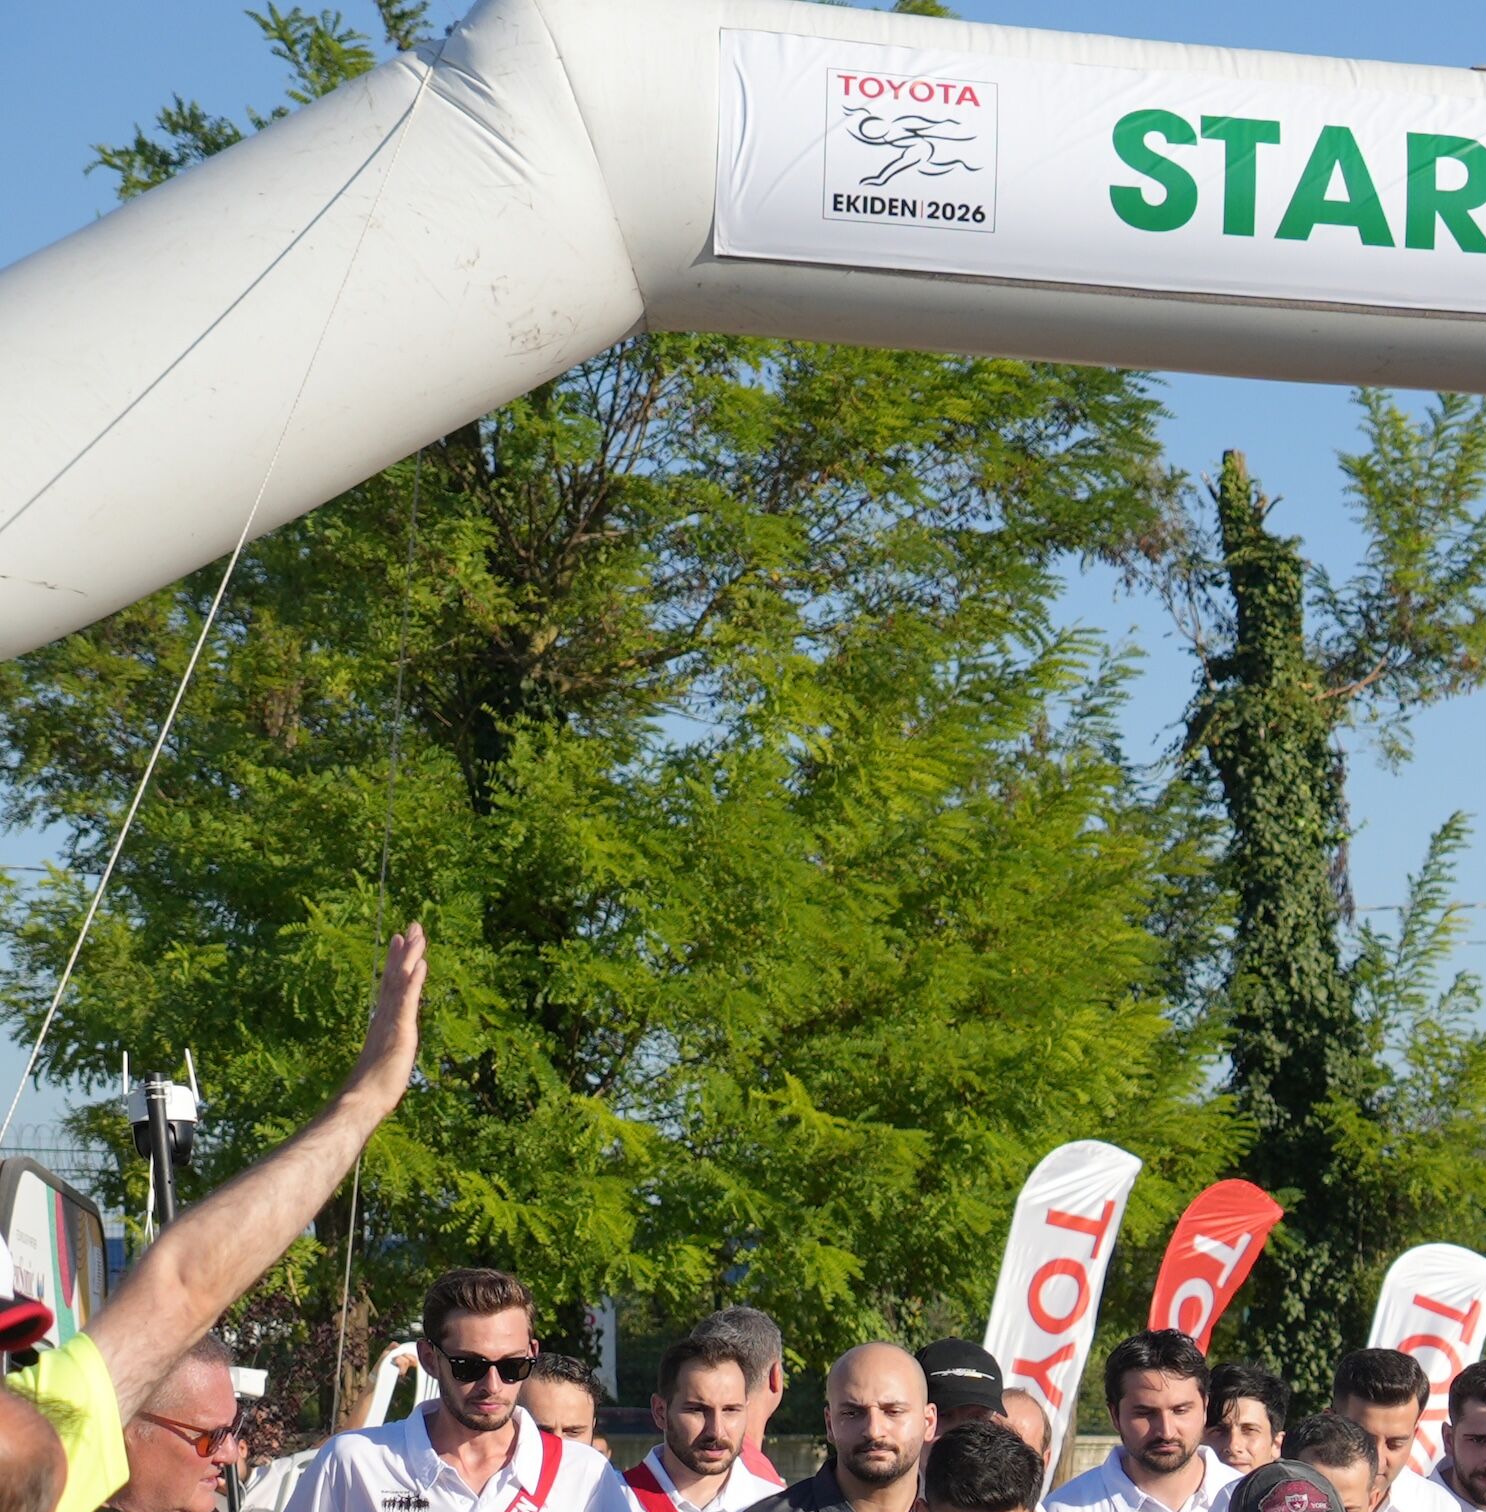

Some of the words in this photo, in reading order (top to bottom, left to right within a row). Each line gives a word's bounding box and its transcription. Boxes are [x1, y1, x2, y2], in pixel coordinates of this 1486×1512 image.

[837, 74, 981, 108] TOYOTA
[832, 193, 917, 218] EKIDEN
[926, 200, 986, 224] 2026
